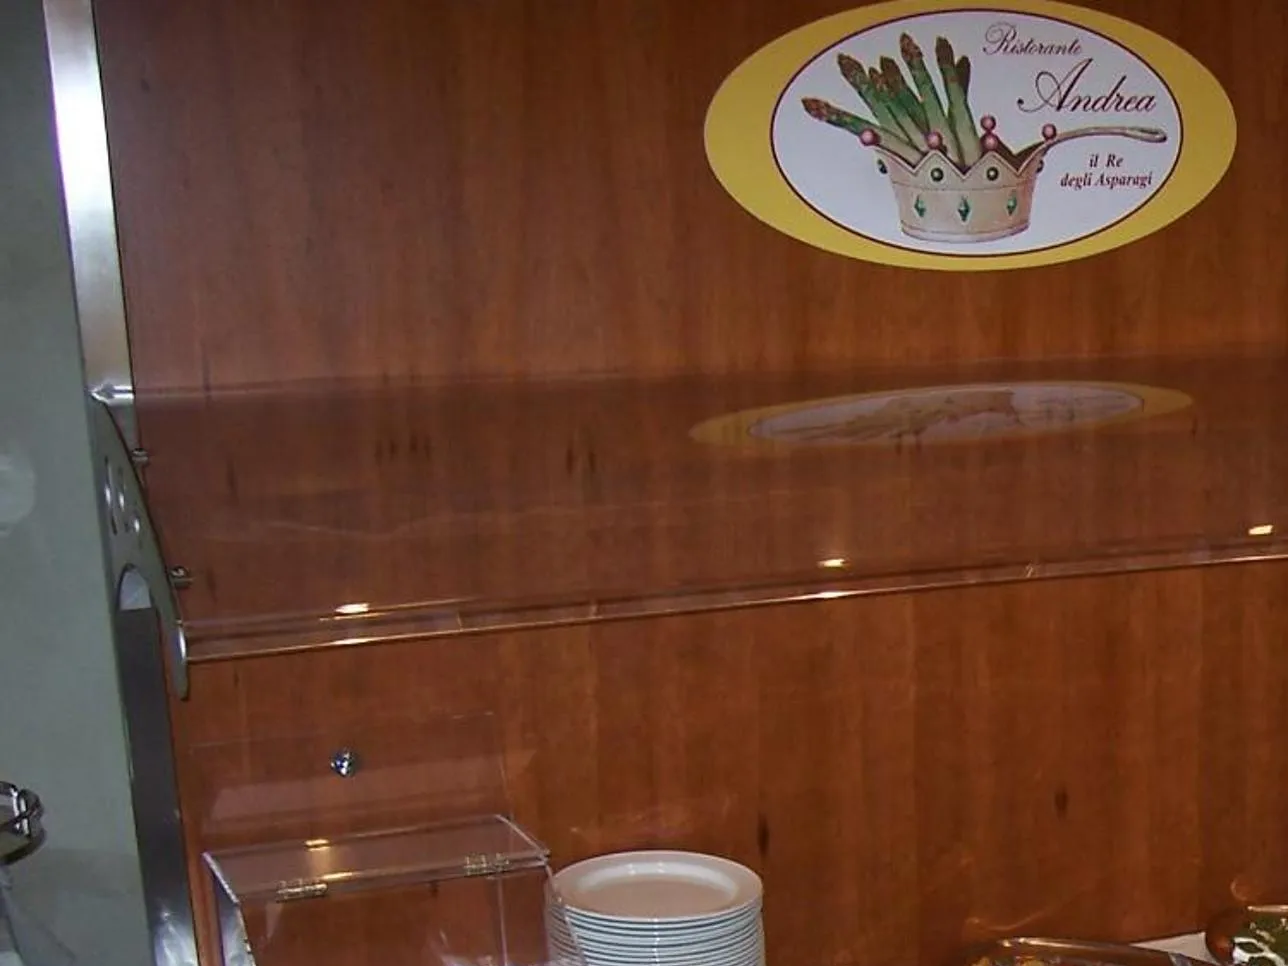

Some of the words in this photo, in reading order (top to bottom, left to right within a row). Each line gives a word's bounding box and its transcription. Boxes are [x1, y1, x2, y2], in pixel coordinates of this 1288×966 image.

[983, 22, 1082, 56] Ristorante
[1017, 58, 1156, 113] Andrea
[1089, 153, 1100, 168] il
[1106, 153, 1124, 168] Re
[1060, 171, 1093, 190] degli
[1095, 171, 1153, 190] Asparagi
